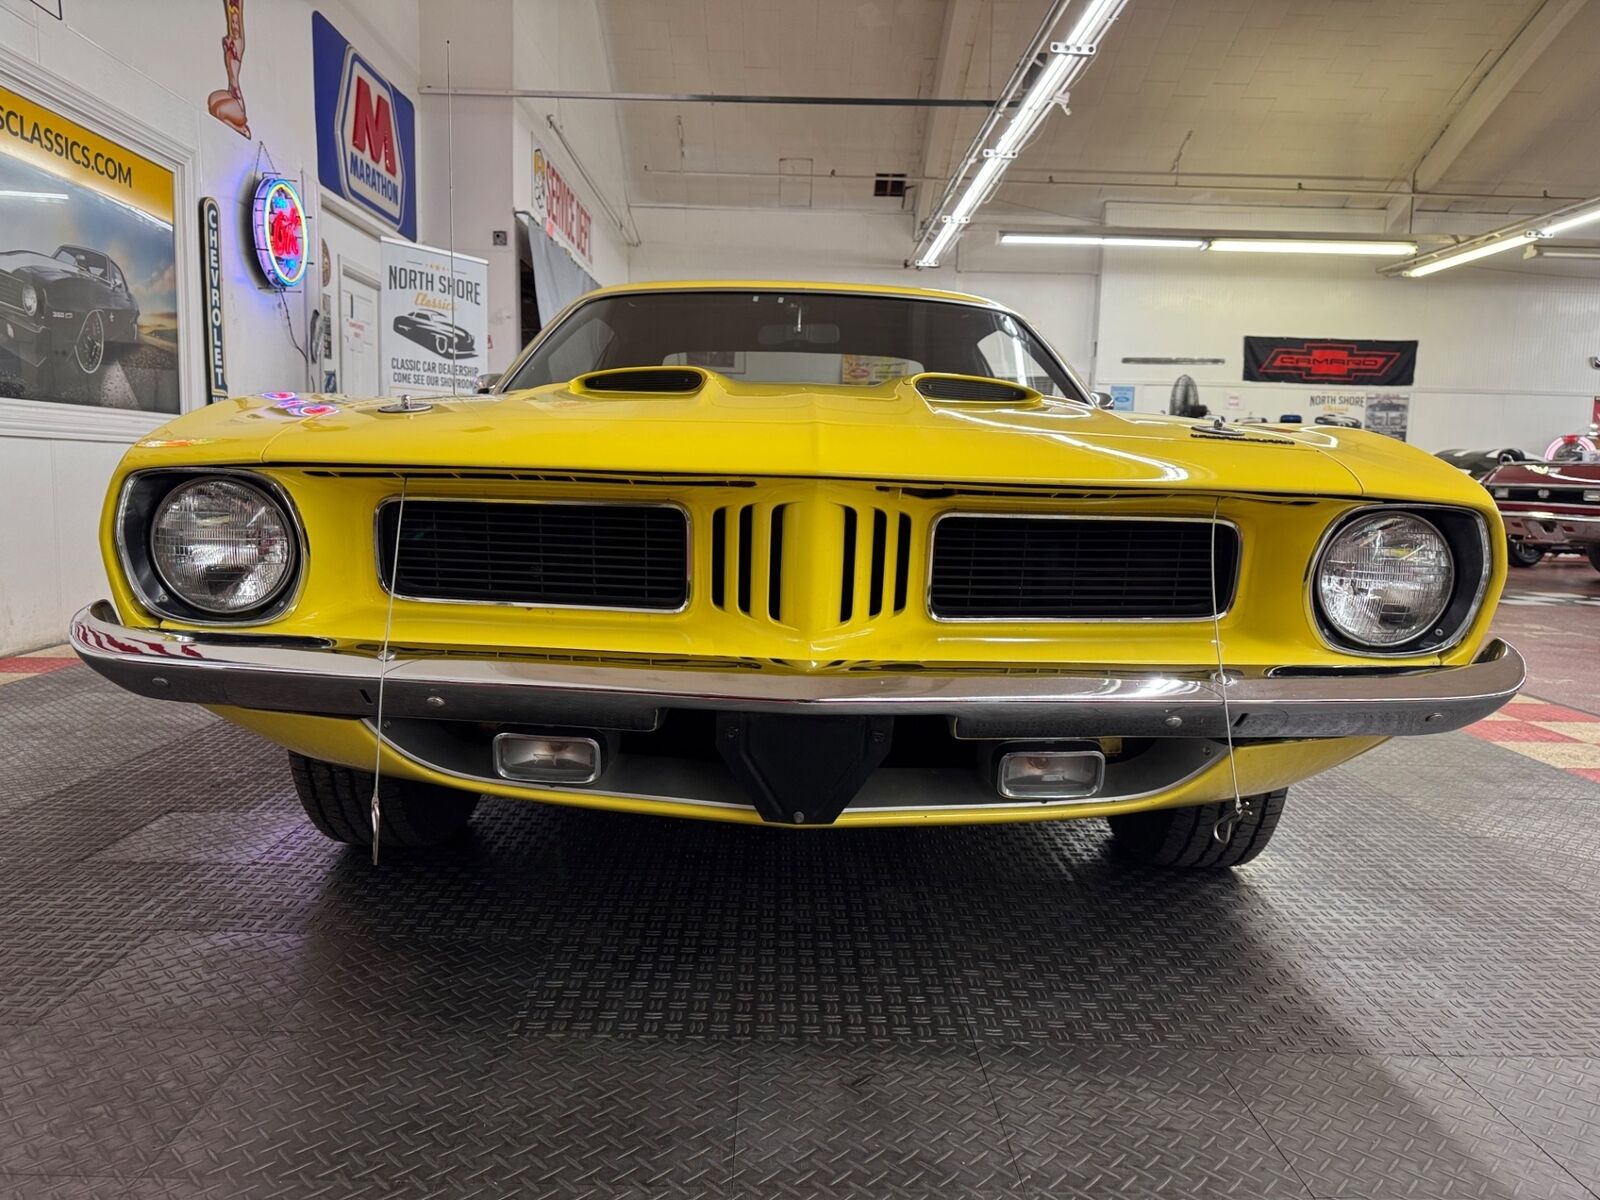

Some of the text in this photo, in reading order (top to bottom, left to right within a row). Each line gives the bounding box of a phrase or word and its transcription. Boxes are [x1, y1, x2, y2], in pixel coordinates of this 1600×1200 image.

[350, 151, 399, 206] MARATHON
[546, 160, 574, 245] SERVICE
[208, 210, 224, 386] CHEVROLET
[388, 265, 481, 305] NORTH SHORE
[391, 358, 480, 377] CLASSIC CAR DEALERSHIP
[1279, 356, 1378, 367] CAMARO
[393, 372, 412, 384] COME
[413, 374, 425, 385] SEE
[426, 375, 439, 387] OUR
[1309, 395, 1337, 407] NORTH
[1338, 396, 1365, 407] SHORE
